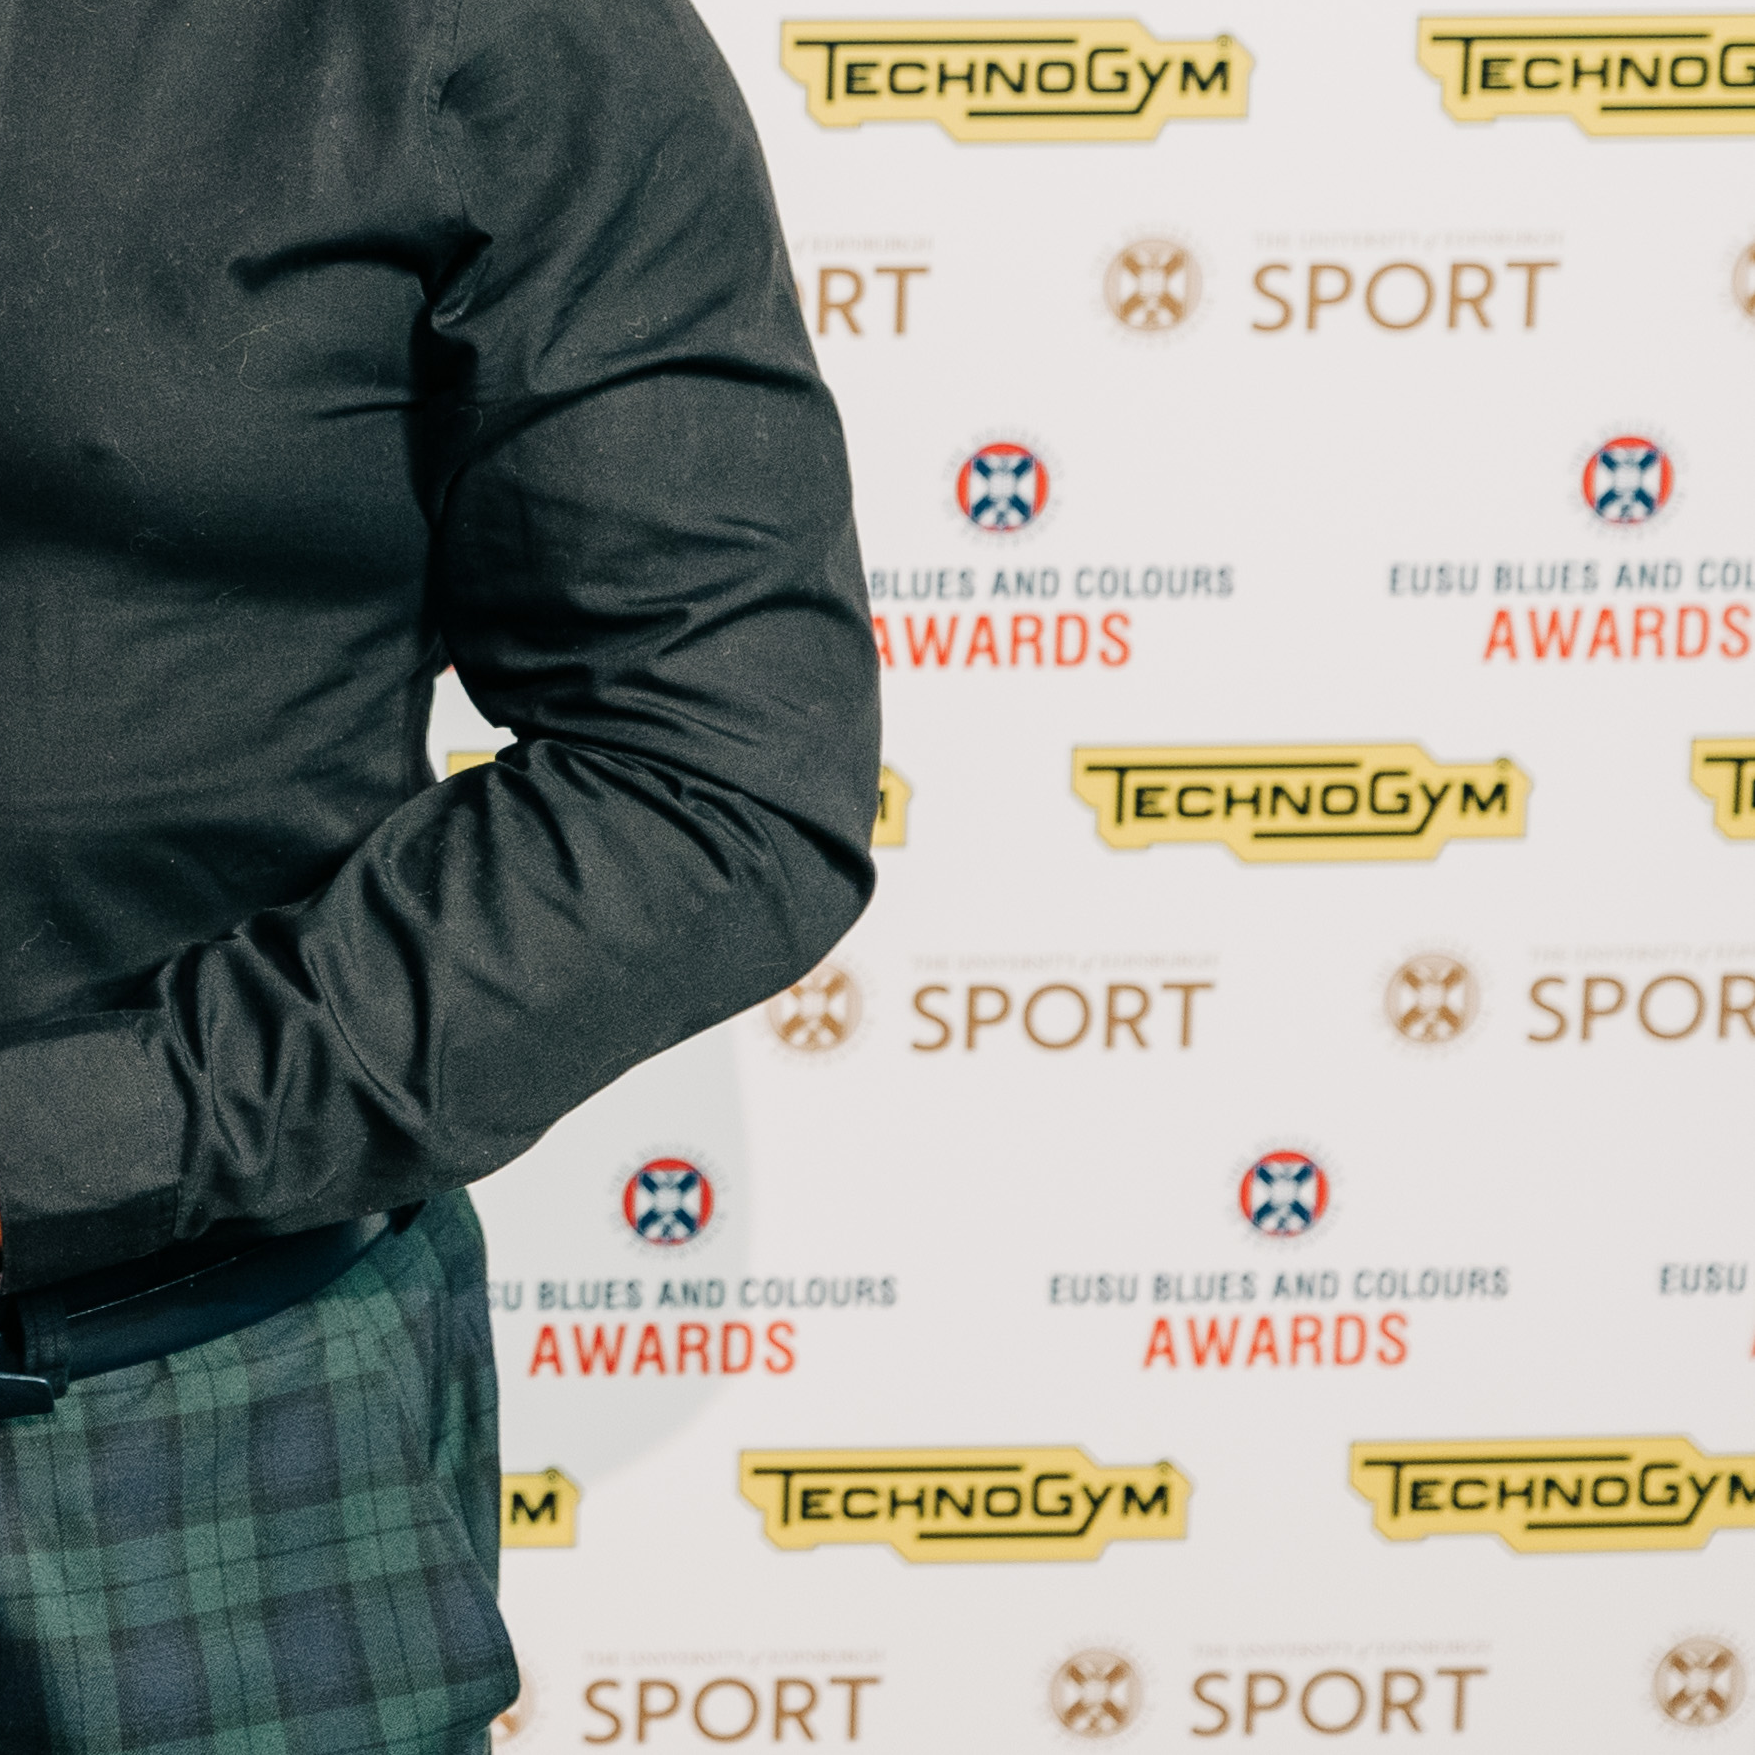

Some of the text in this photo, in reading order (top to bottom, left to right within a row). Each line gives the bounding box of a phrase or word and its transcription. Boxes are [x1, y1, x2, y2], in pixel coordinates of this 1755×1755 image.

[1251, 260, 1560, 334] SPORT
[1483, 603, 1751, 661] AWARDS
[911, 981, 1214, 1055] SPORT
[1048, 1266, 1509, 1306] EUSU BLUES AND COLOURS
[529, 1320, 795, 1376] AWARDS
[1143, 1312, 1408, 1368] AWARDS
[582, 1675, 881, 1746] SPORT
[1190, 1666, 1488, 1739] SPORT
